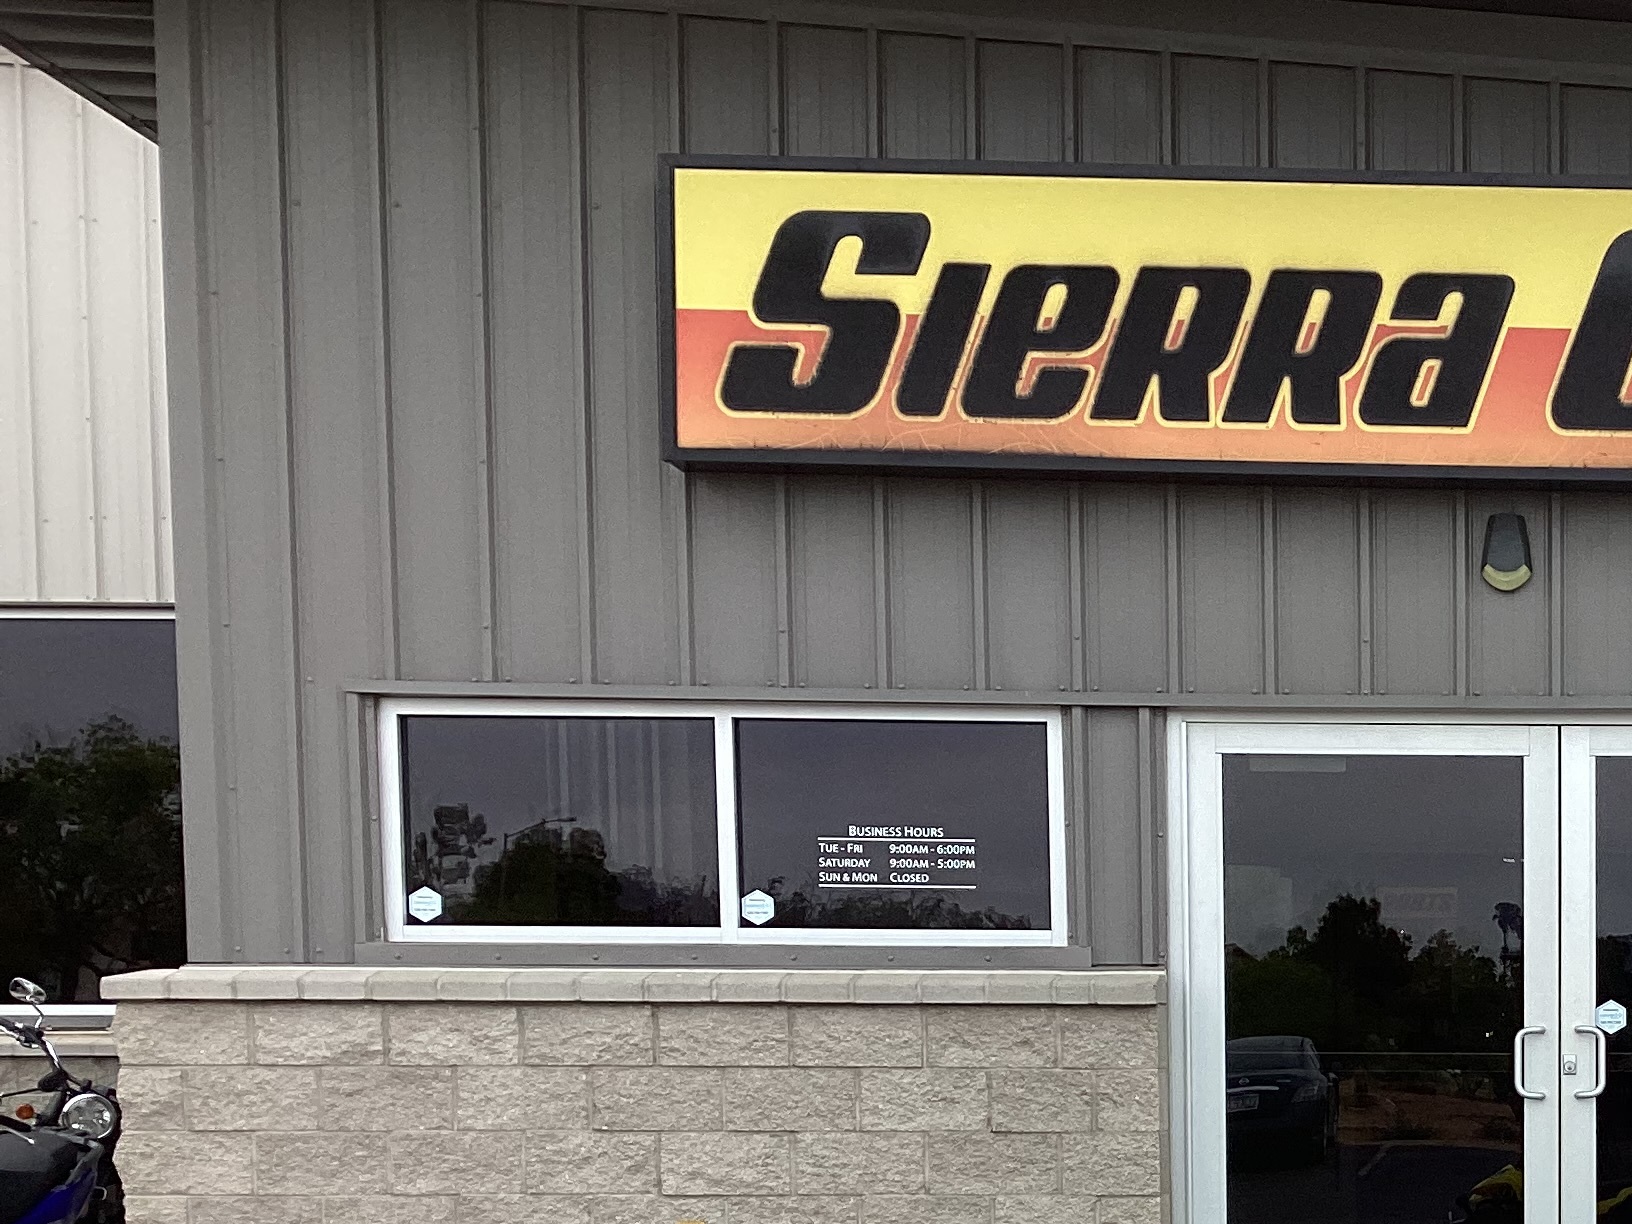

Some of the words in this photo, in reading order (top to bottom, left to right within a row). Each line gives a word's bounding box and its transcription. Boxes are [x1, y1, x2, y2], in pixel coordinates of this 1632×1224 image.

[848, 825, 902, 837] BUSINESS
[903, 826, 944, 837] HOURS
[818, 843, 839, 853] TUE
[847, 843, 863, 853] FRI
[888, 844, 929, 854] 9:00AM
[936, 845, 975, 855] 6:00PM
[818, 857, 871, 868] SATURDAY
[889, 858, 929, 868] 9:00AM
[937, 859, 976, 869] 5:00PM
[818, 871, 841, 882] SUN
[842, 873, 851, 882] &
[851, 872, 878, 882] MON
[889, 872, 930, 883] CLOSED
